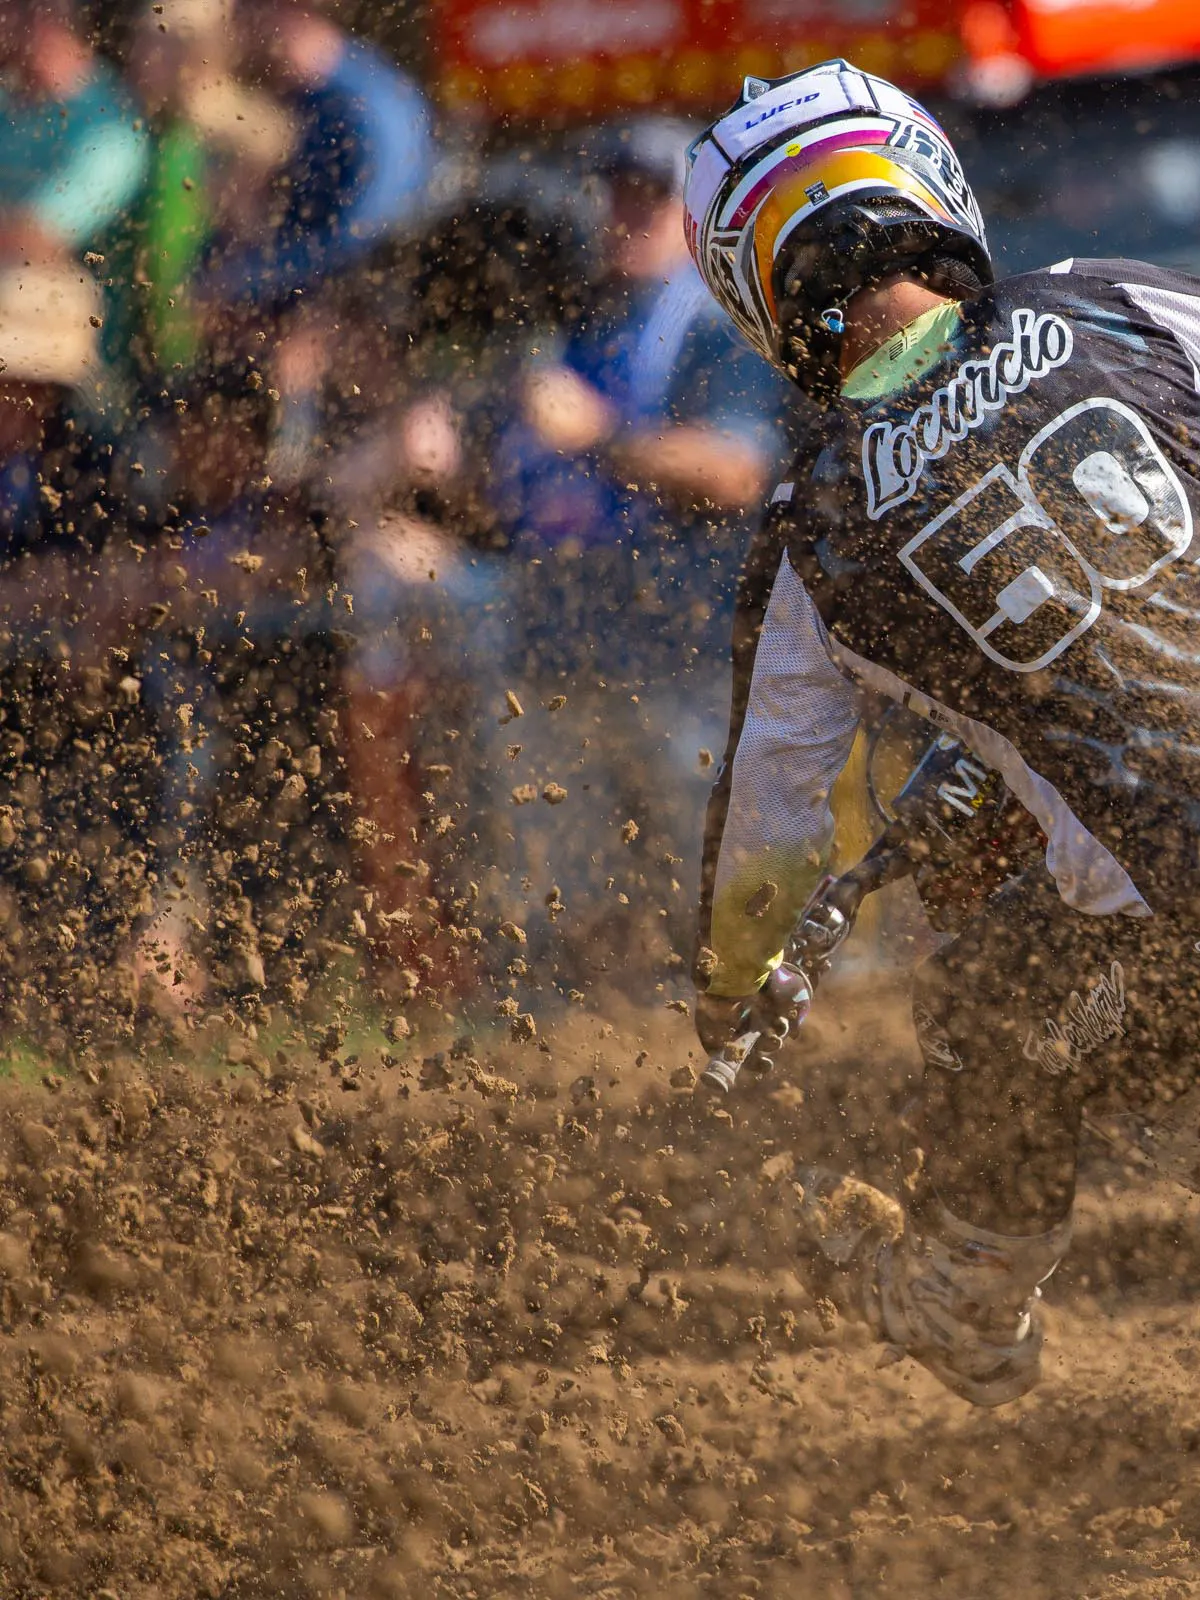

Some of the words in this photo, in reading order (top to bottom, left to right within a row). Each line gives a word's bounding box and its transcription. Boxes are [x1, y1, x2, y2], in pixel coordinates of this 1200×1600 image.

[745, 92, 820, 130] LUCID
[861, 308, 1073, 521] Locurcio
[897, 397, 1193, 672] 50
